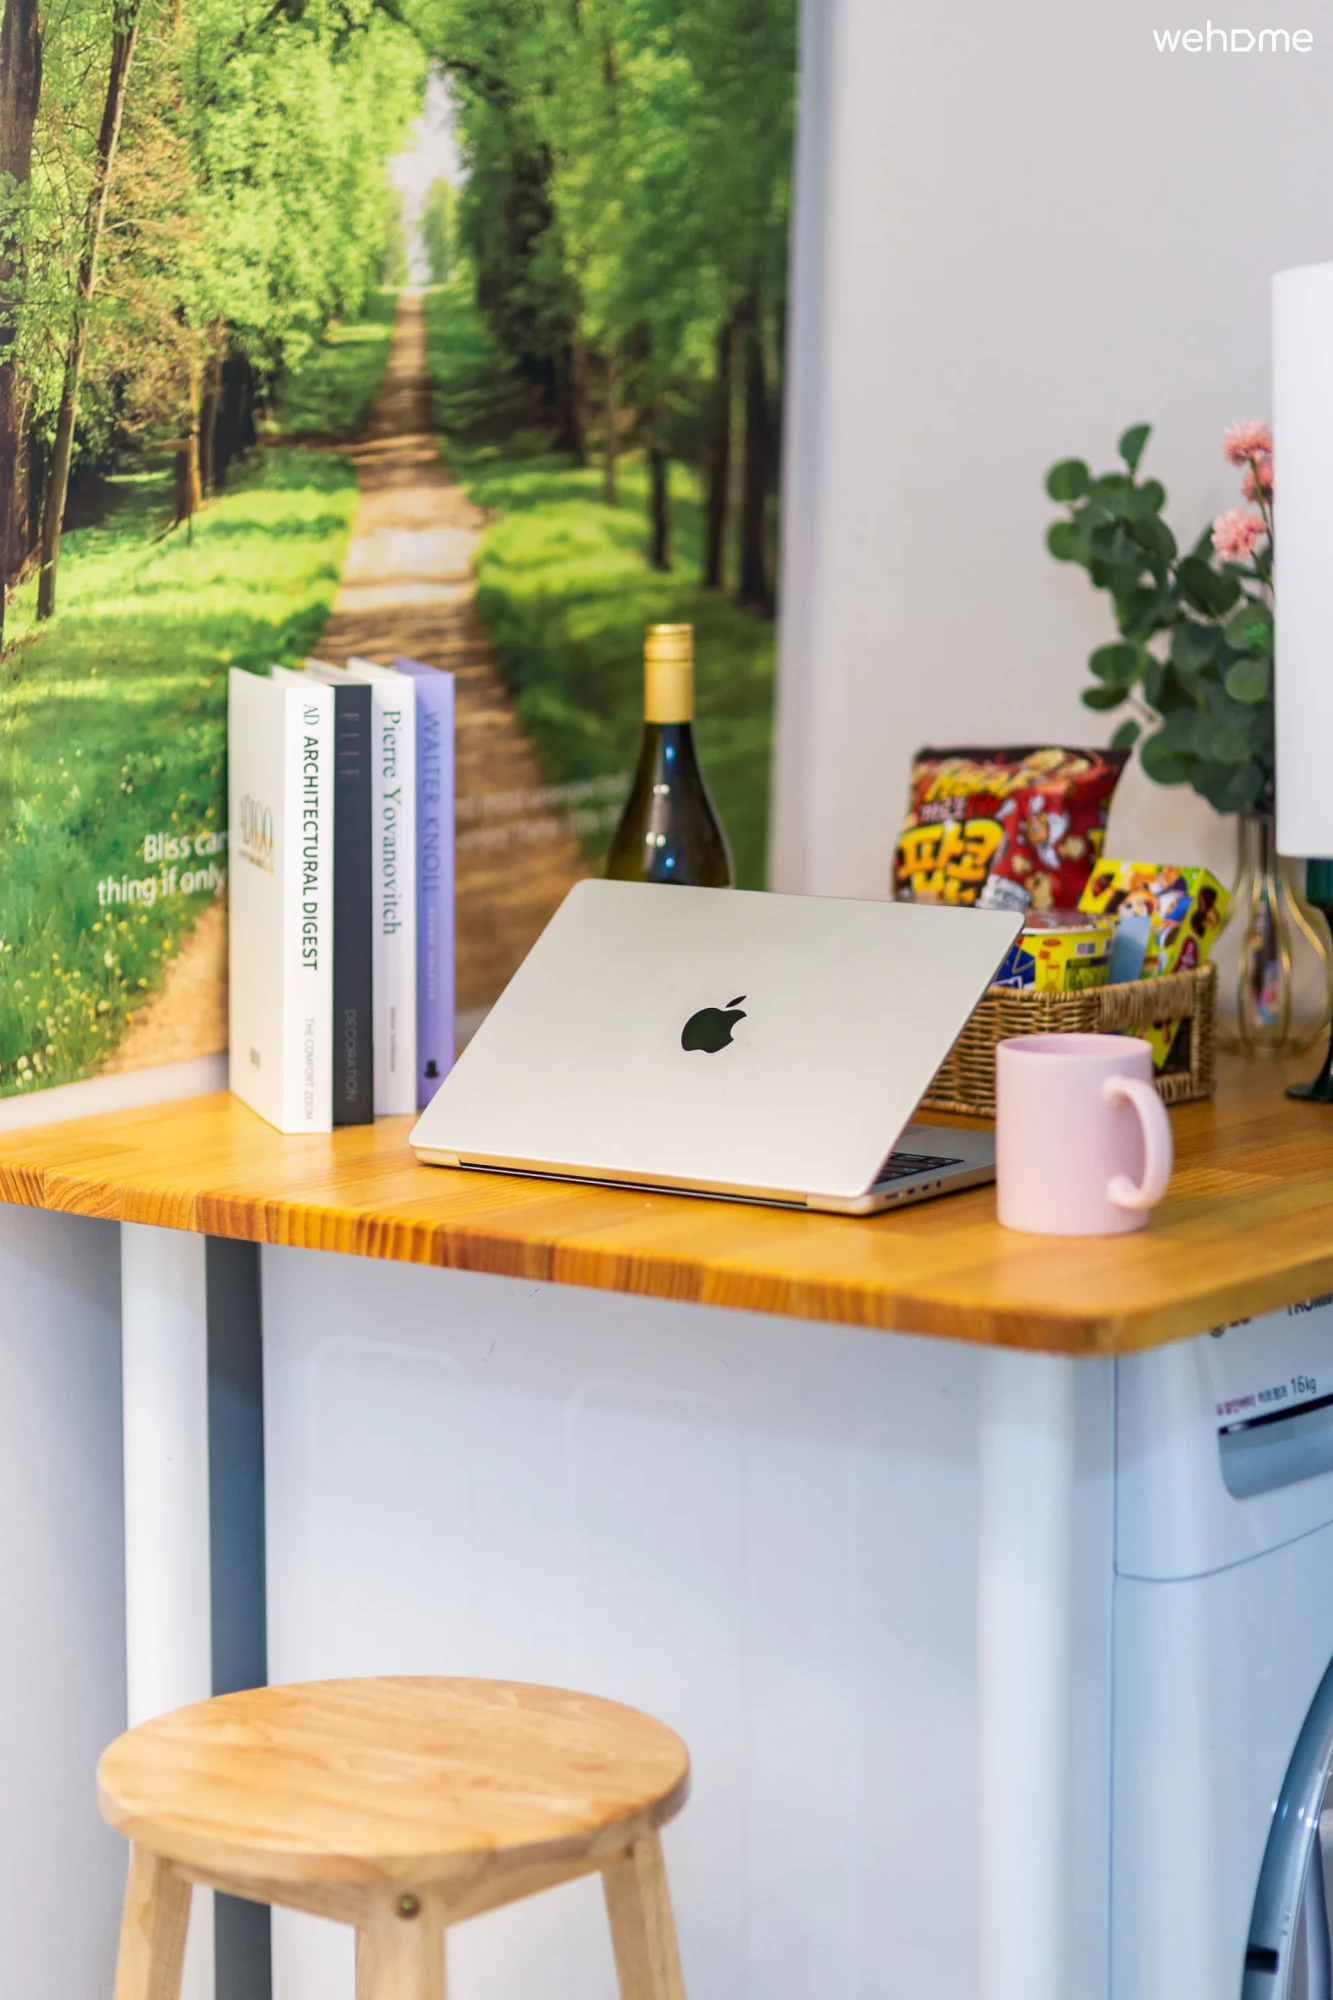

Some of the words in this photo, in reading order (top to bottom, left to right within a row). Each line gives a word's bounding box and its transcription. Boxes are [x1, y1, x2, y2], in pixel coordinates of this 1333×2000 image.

[303, 703, 320, 726] AD
[383, 710, 402, 778] Pierre
[422, 710, 441, 805] WALTER
[143, 832, 191, 864] Bliss
[303, 735, 319, 896] ARCHITECTURAL
[97, 875, 157, 907] thing
[161, 865, 178, 897] if
[180, 861, 226, 894] only
[383, 786, 402, 936] Yovanovitch
[422, 816, 441, 893] KNOLL
[302, 902, 318, 970] DIGEST
[344, 1009, 358, 1101] DECORATION
[1290, 1375, 1317, 1395] 16kg
